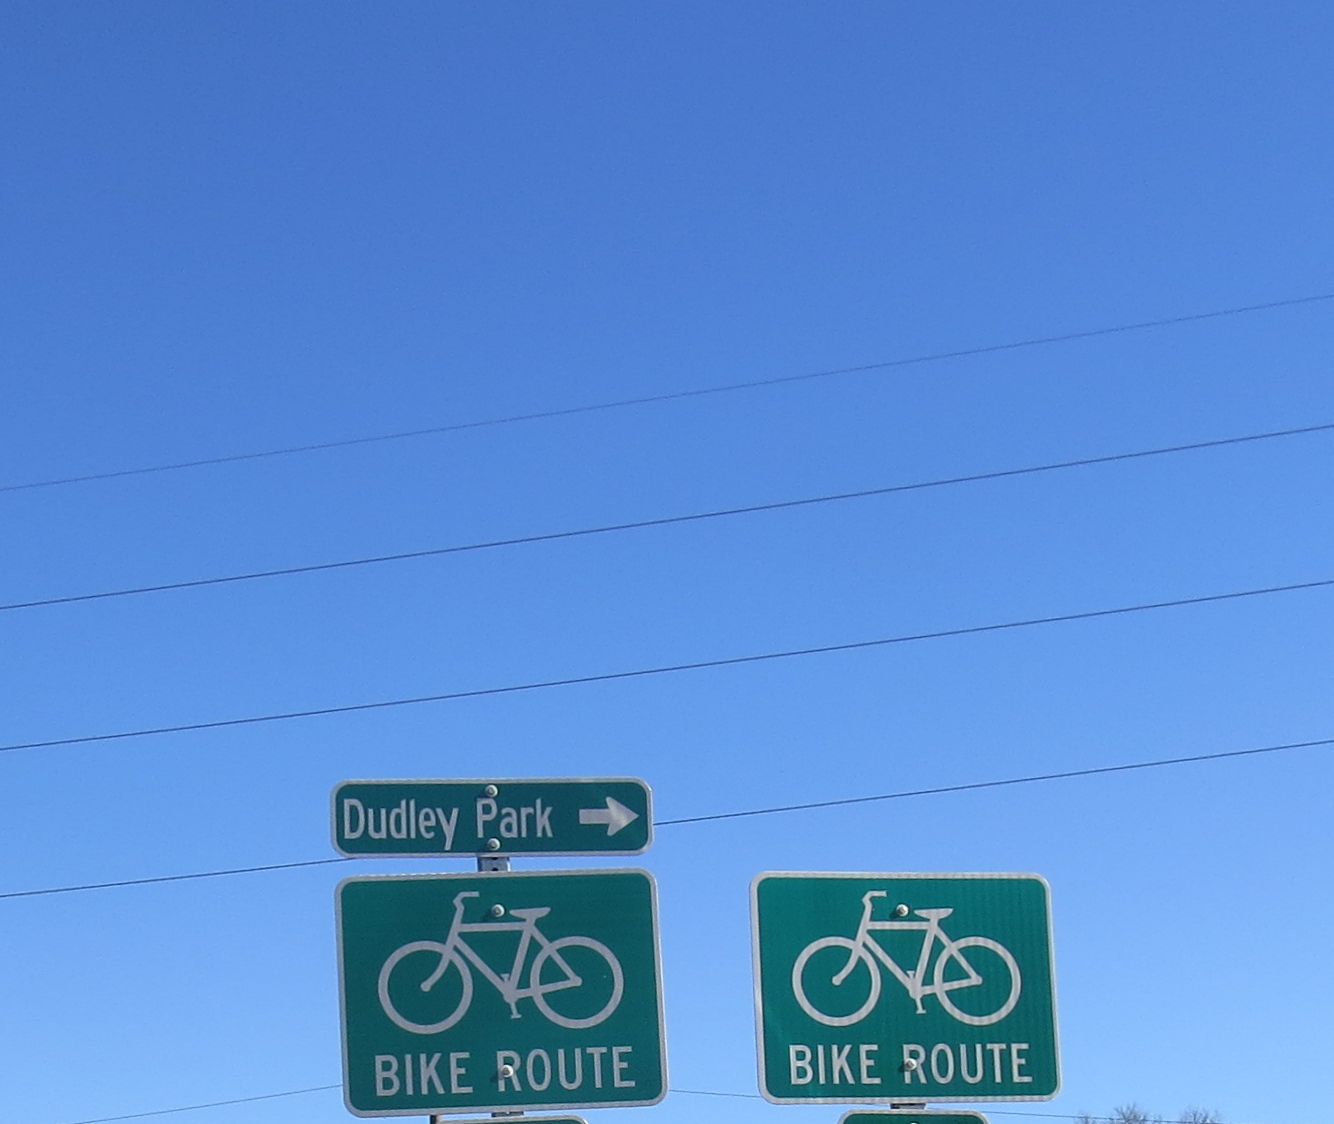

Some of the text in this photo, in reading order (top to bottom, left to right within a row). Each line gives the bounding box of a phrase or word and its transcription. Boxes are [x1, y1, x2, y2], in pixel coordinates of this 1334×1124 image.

[342, 798, 554, 852] Dudley Park
[374, 1045, 637, 1098] BIKE ROUTE
[788, 1042, 1034, 1086] BIKE ROUTE
